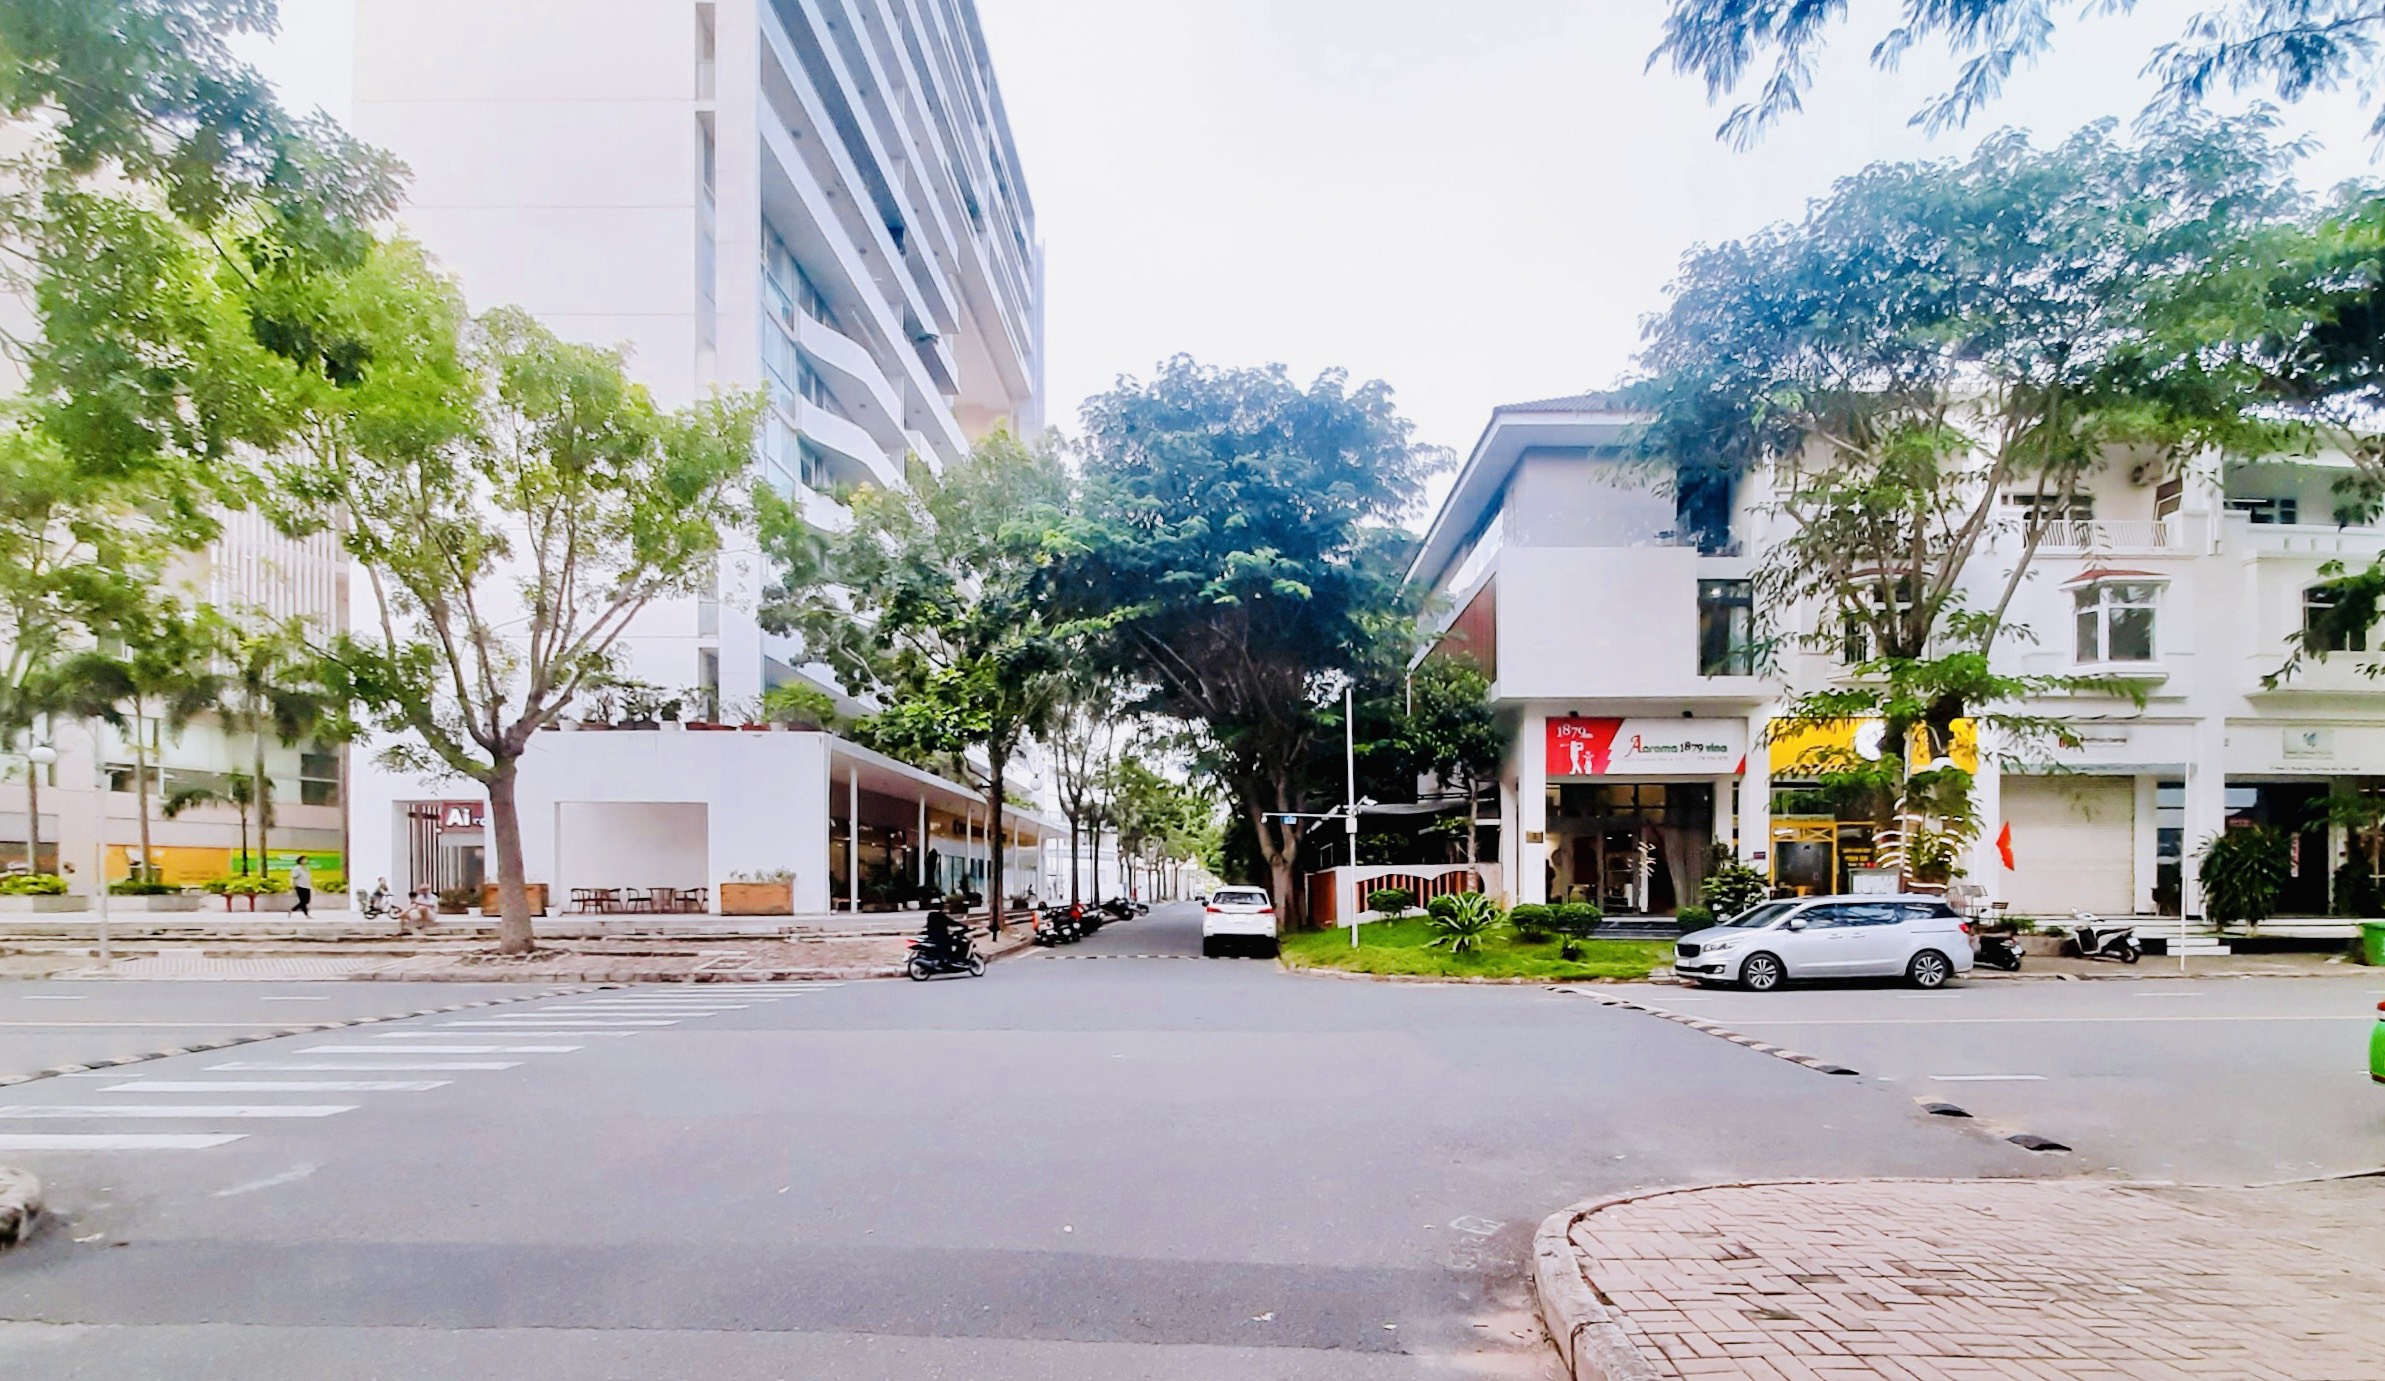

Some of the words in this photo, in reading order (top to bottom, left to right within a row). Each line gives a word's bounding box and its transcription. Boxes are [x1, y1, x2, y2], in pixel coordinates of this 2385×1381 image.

[1557, 723, 1587, 739] 1879
[1680, 742, 1704, 753] 1879
[446, 807, 470, 827] Ai
